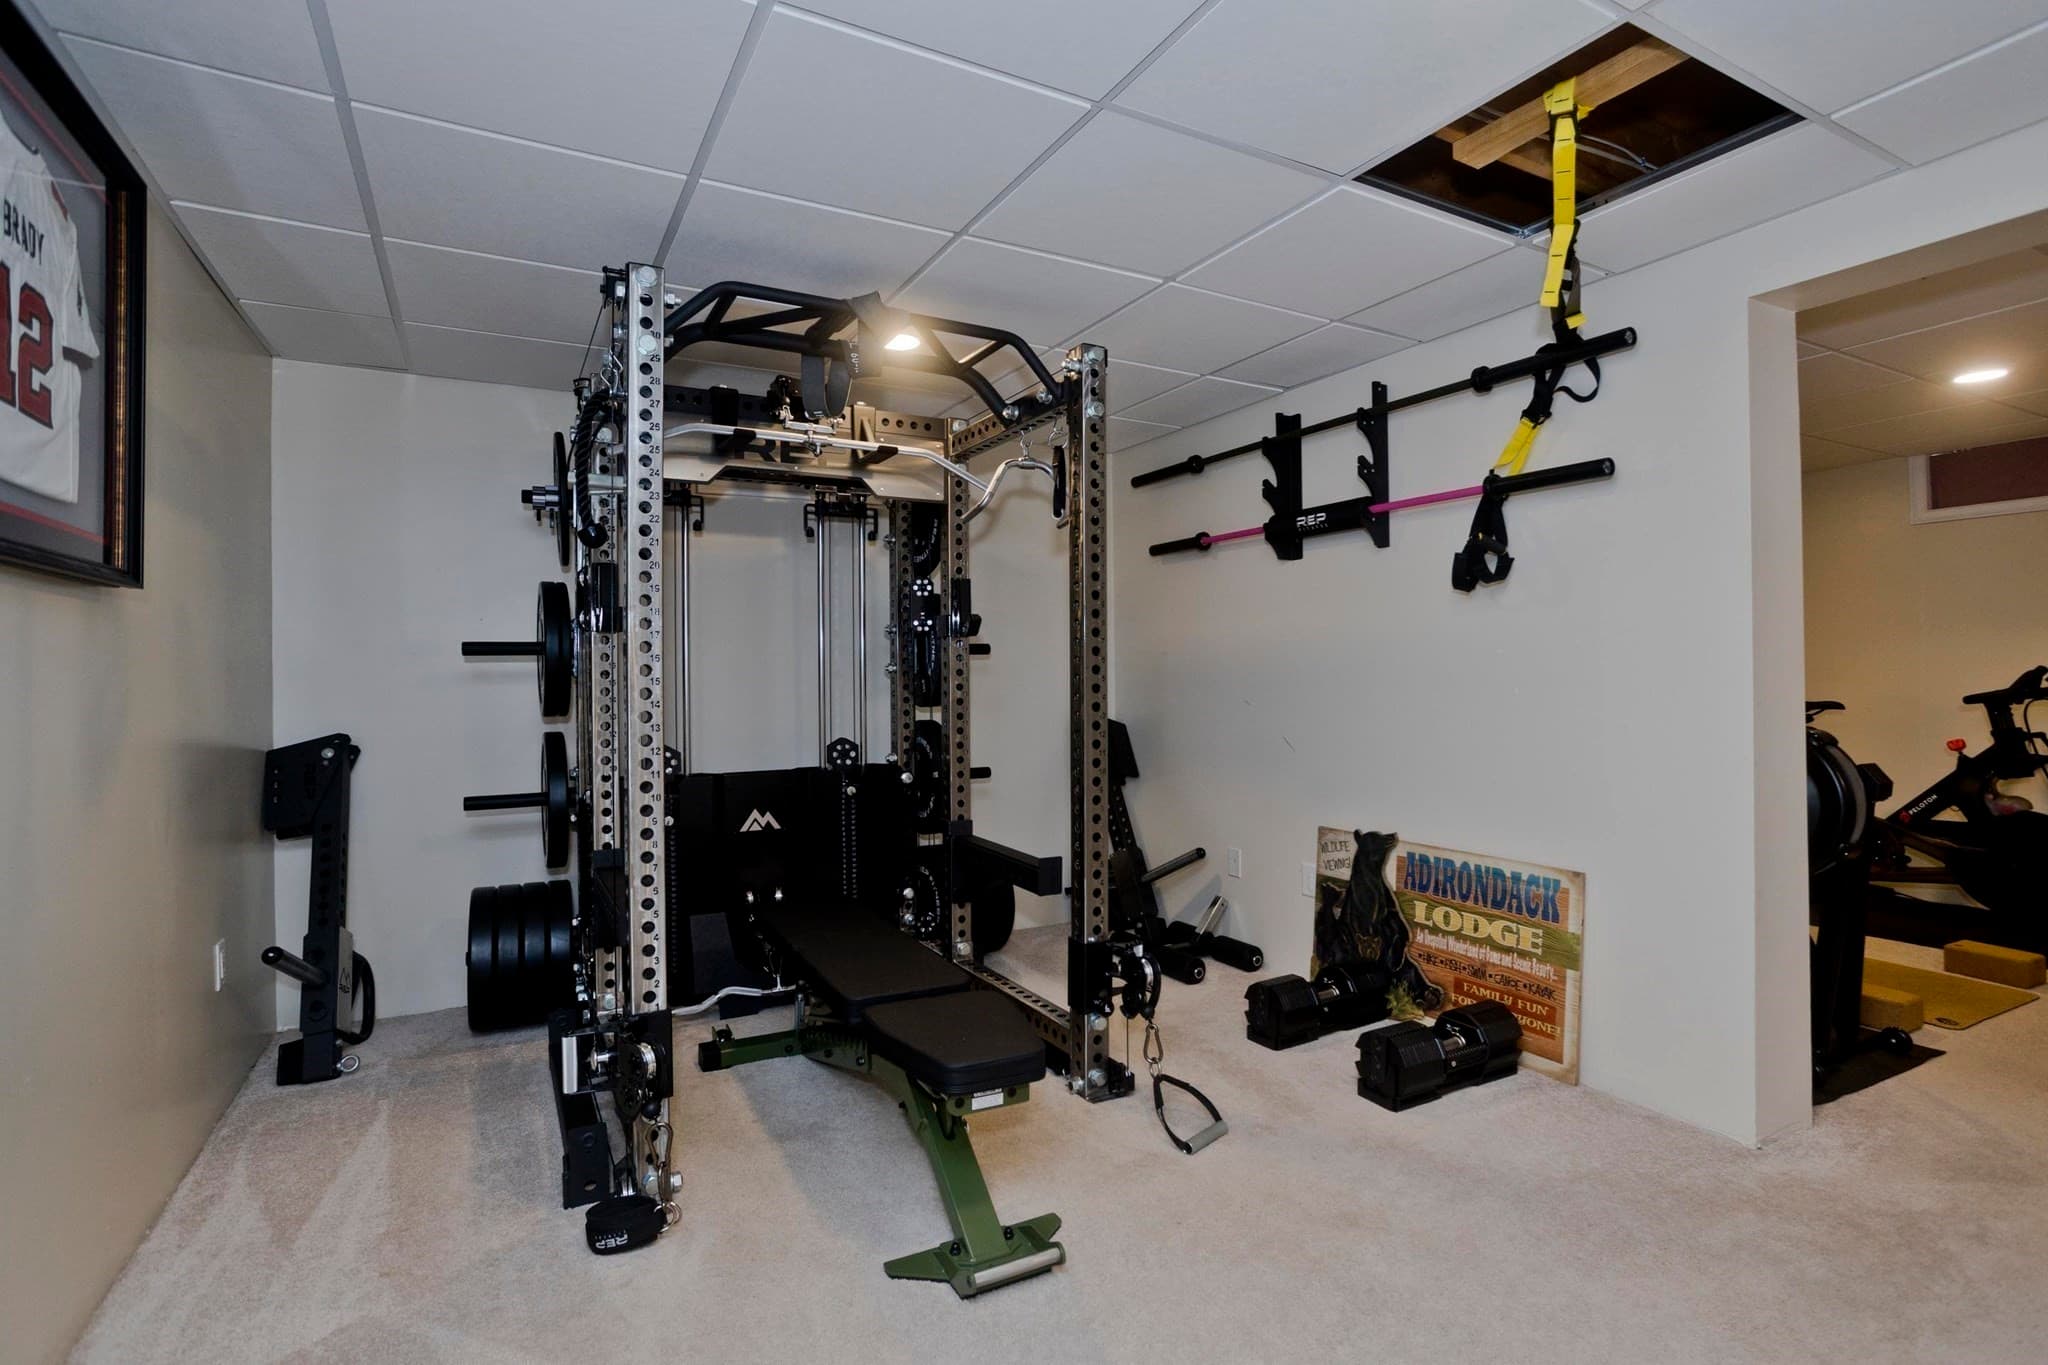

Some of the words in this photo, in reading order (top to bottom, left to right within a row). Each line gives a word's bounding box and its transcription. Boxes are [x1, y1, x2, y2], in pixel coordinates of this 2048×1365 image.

[3, 196, 45, 266] BRADY
[0, 260, 54, 430] 12
[1296, 512, 1326, 528] REP
[649, 538, 659, 546] 21
[649, 561, 660, 569] 20
[650, 677, 660, 685] 15
[651, 724, 660, 732] 13
[651, 747, 661, 755] 12
[1908, 794, 1937, 816] PELOTON
[1320, 840, 1351, 855] WILDLIFE
[1404, 852, 1560, 924] ADIRONDACK
[1412, 900, 1543, 955] LODGE
[654, 957, 660, 965] 3
[654, 980, 660, 988] 2
[1494, 973, 1520, 991] CANOE
[1463, 982, 1513, 1005] FAMILY
[1518, 999, 1550, 1016] FUN
[595, 1234, 628, 1249] REP
